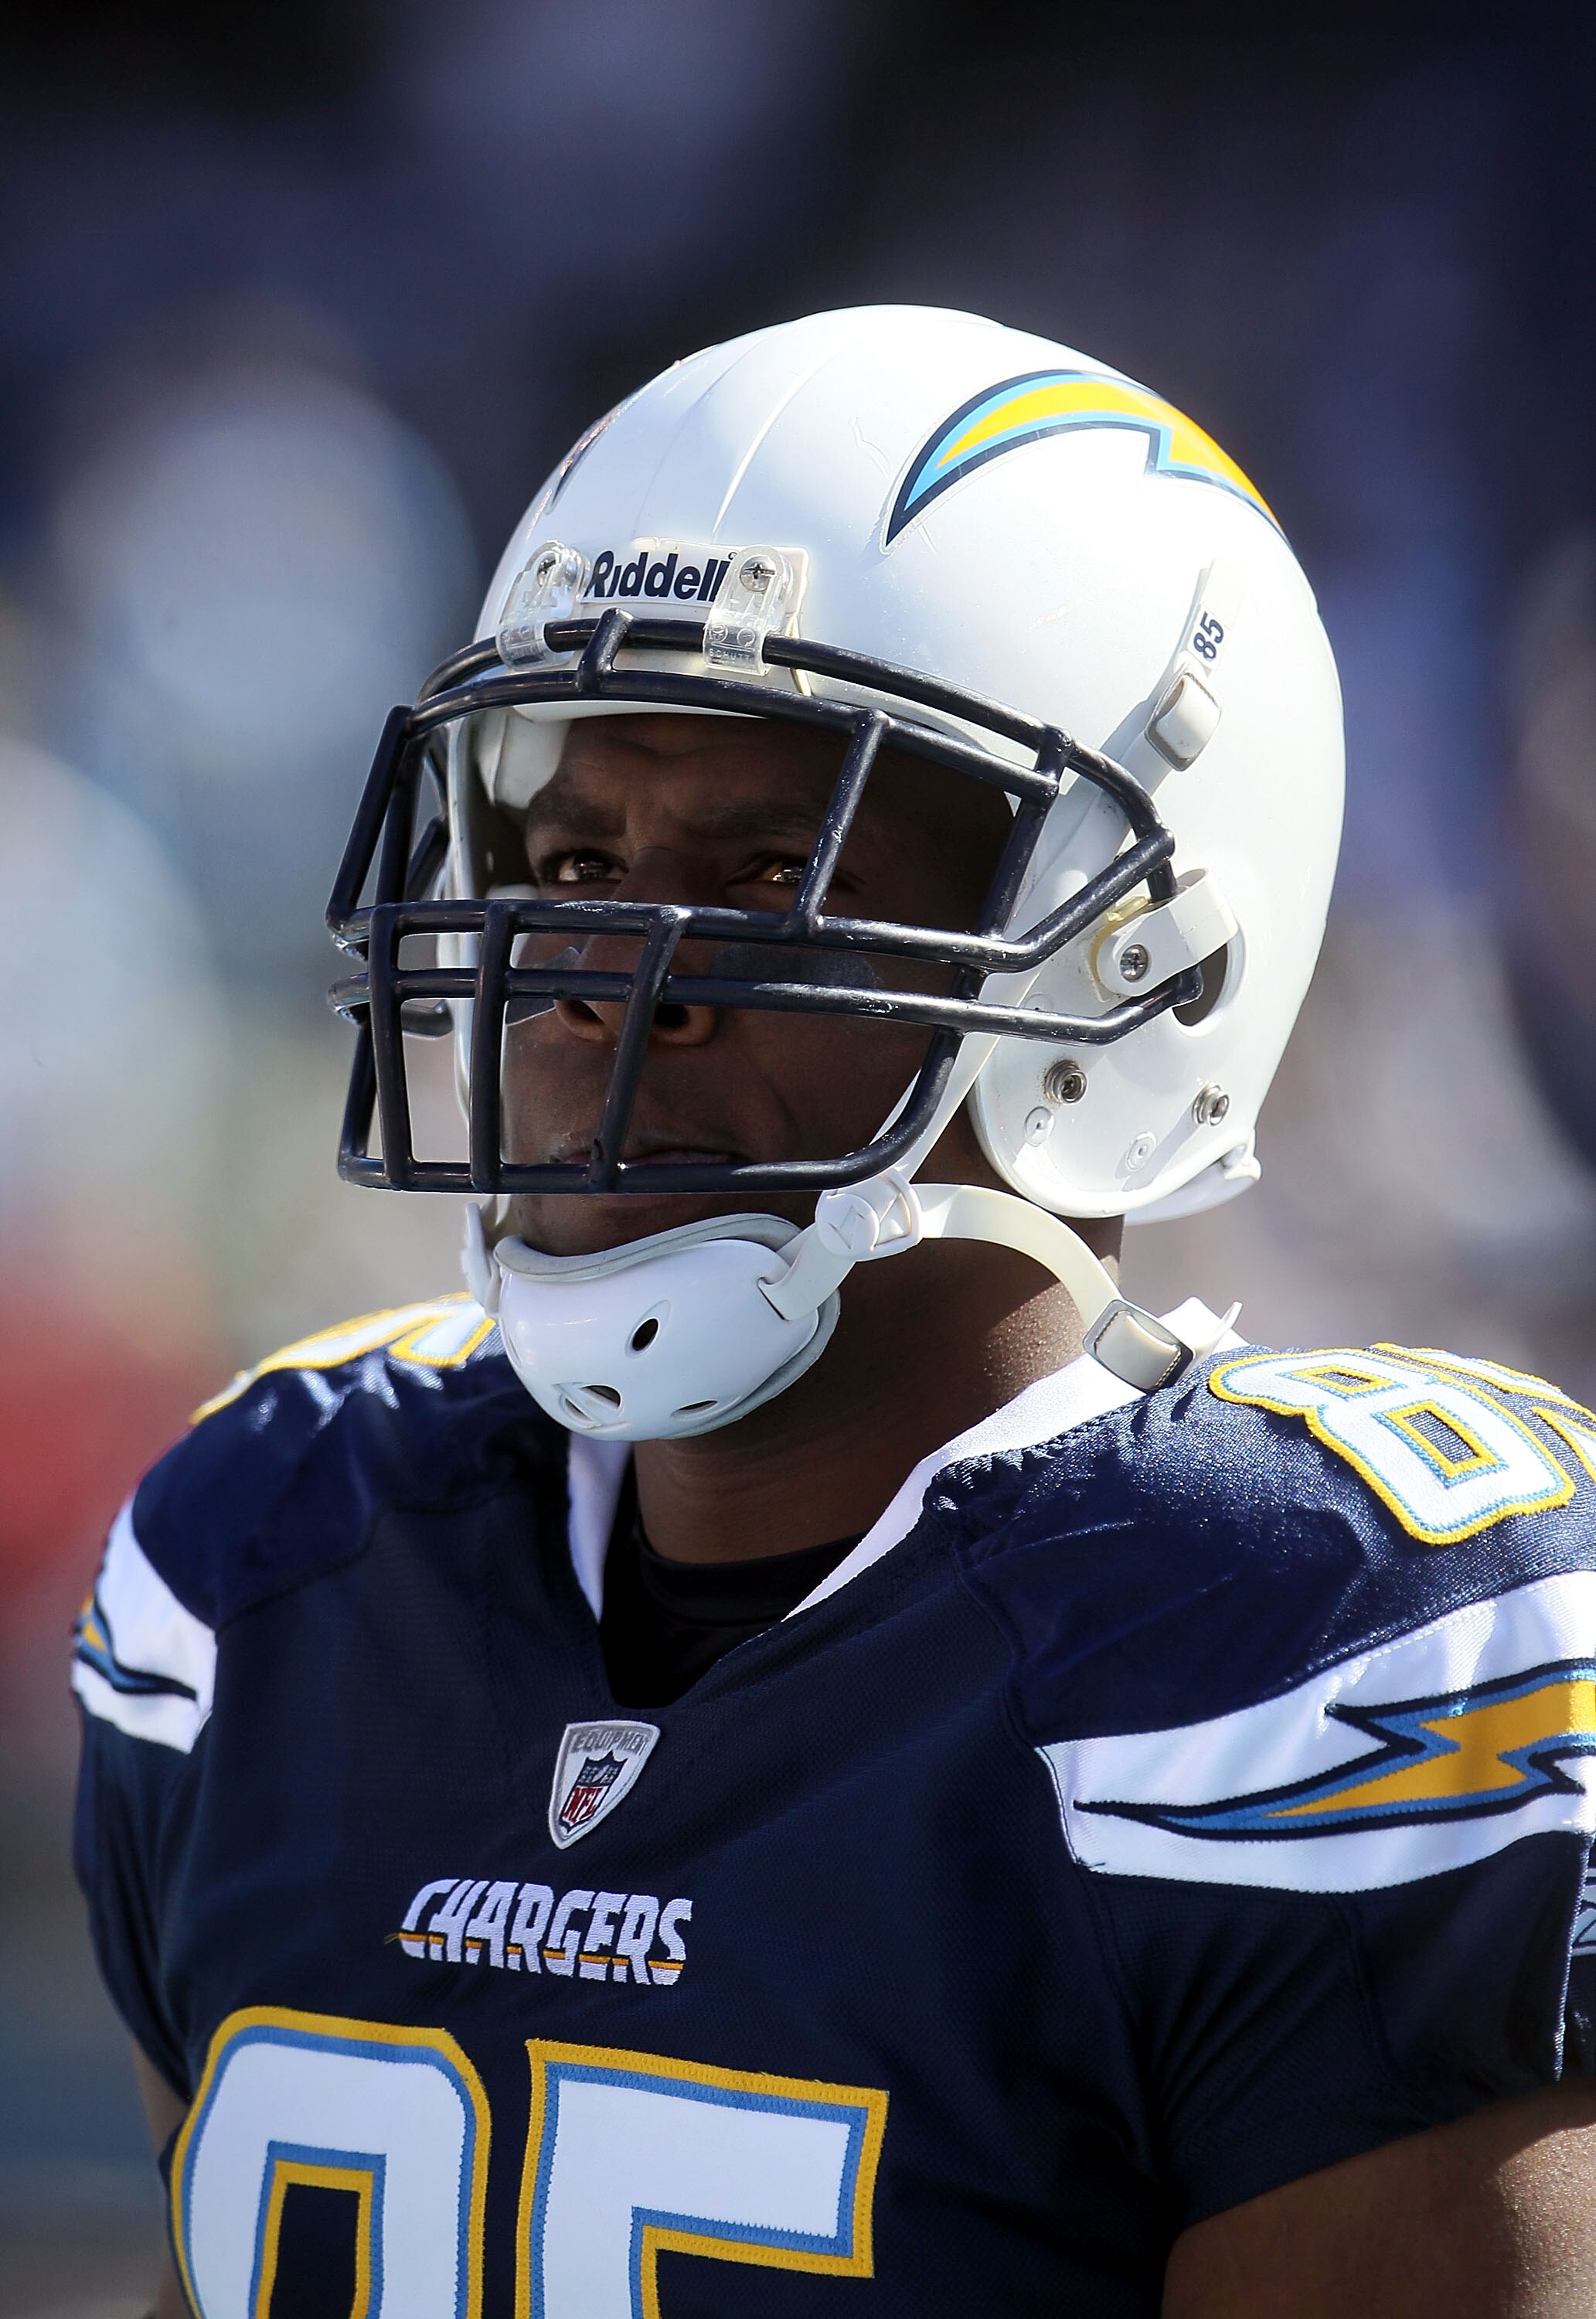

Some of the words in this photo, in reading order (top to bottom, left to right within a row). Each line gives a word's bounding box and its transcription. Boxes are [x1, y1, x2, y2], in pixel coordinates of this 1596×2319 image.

[584, 550, 730, 602] Riddell
[1193, 611, 1223, 660] 85
[563, 1786, 603, 1823] NFL
[398, 1879, 693, 1985] CHARGERS
